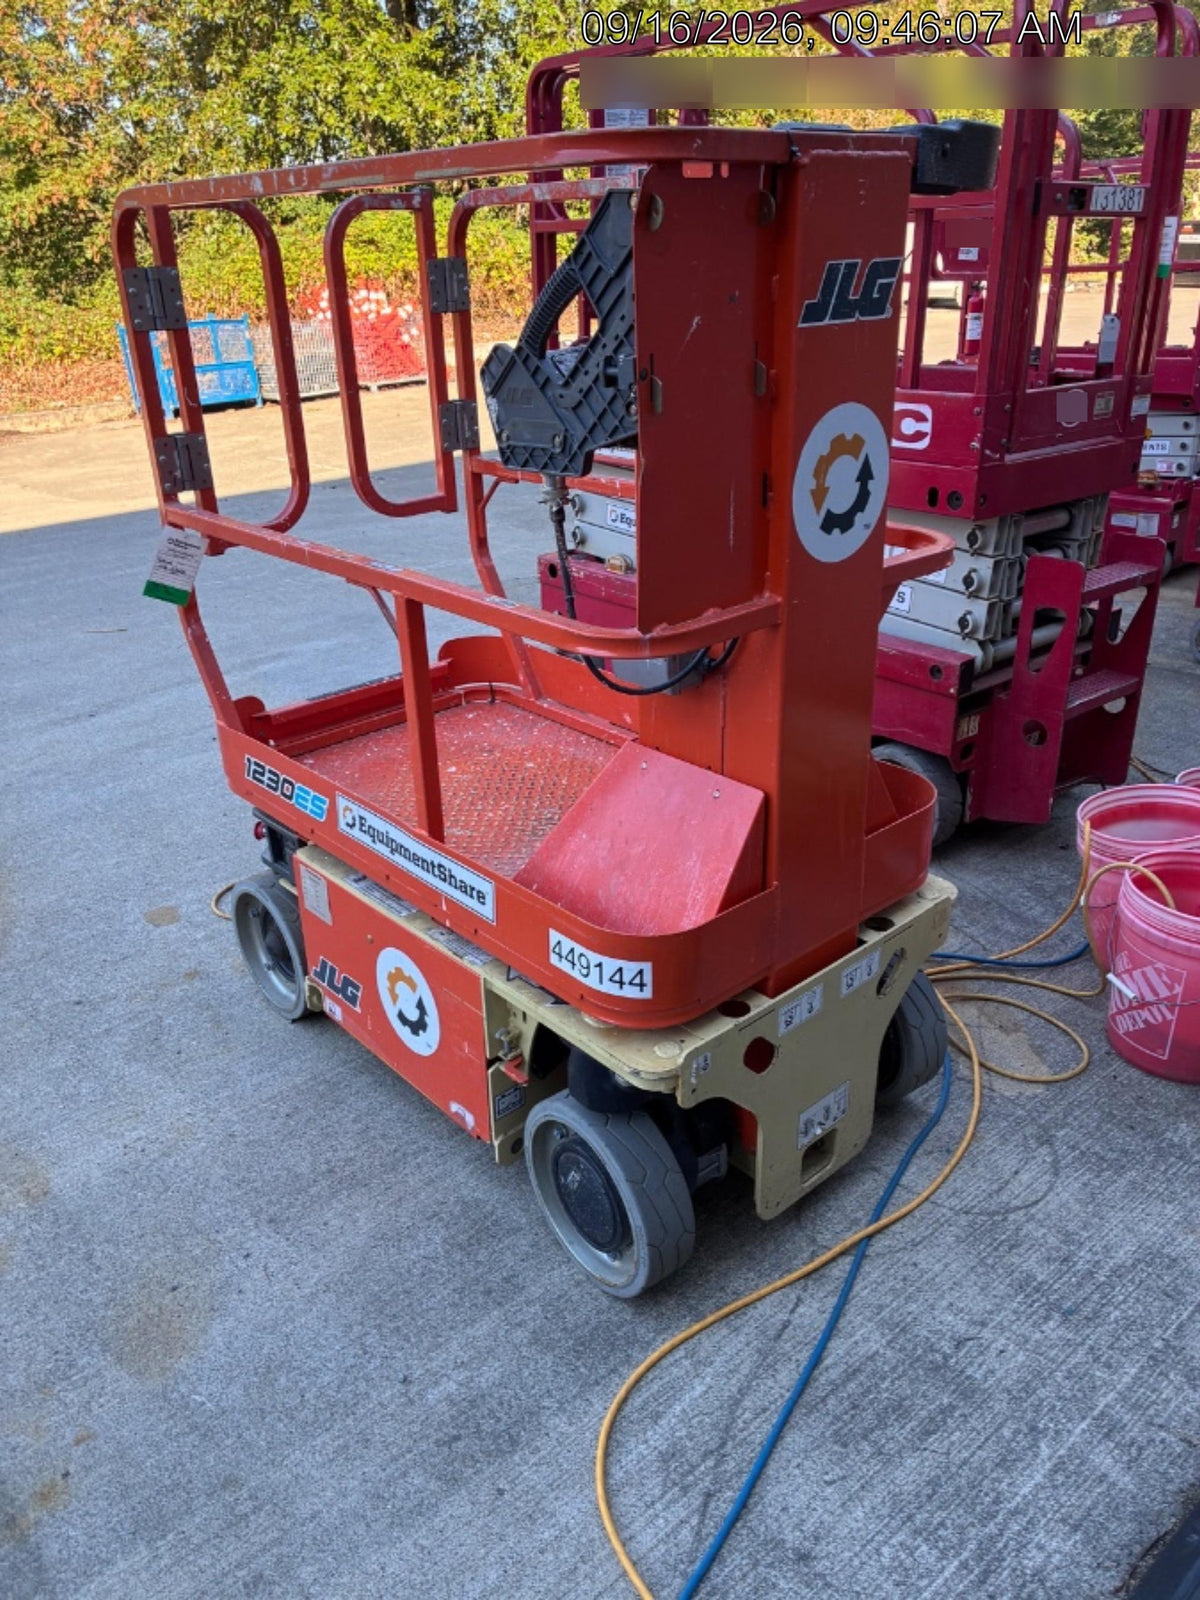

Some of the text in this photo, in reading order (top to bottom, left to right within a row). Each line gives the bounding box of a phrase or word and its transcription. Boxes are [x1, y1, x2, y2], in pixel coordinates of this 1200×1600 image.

[800, 257, 903, 328] JLG
[244, 754, 330, 822] 1230ES
[358, 814, 487, 907] EquipmentShare
[309, 955, 363, 1013] JLG
[551, 939, 648, 993] 449144
[1115, 1004, 1175, 1035] DEPOT
